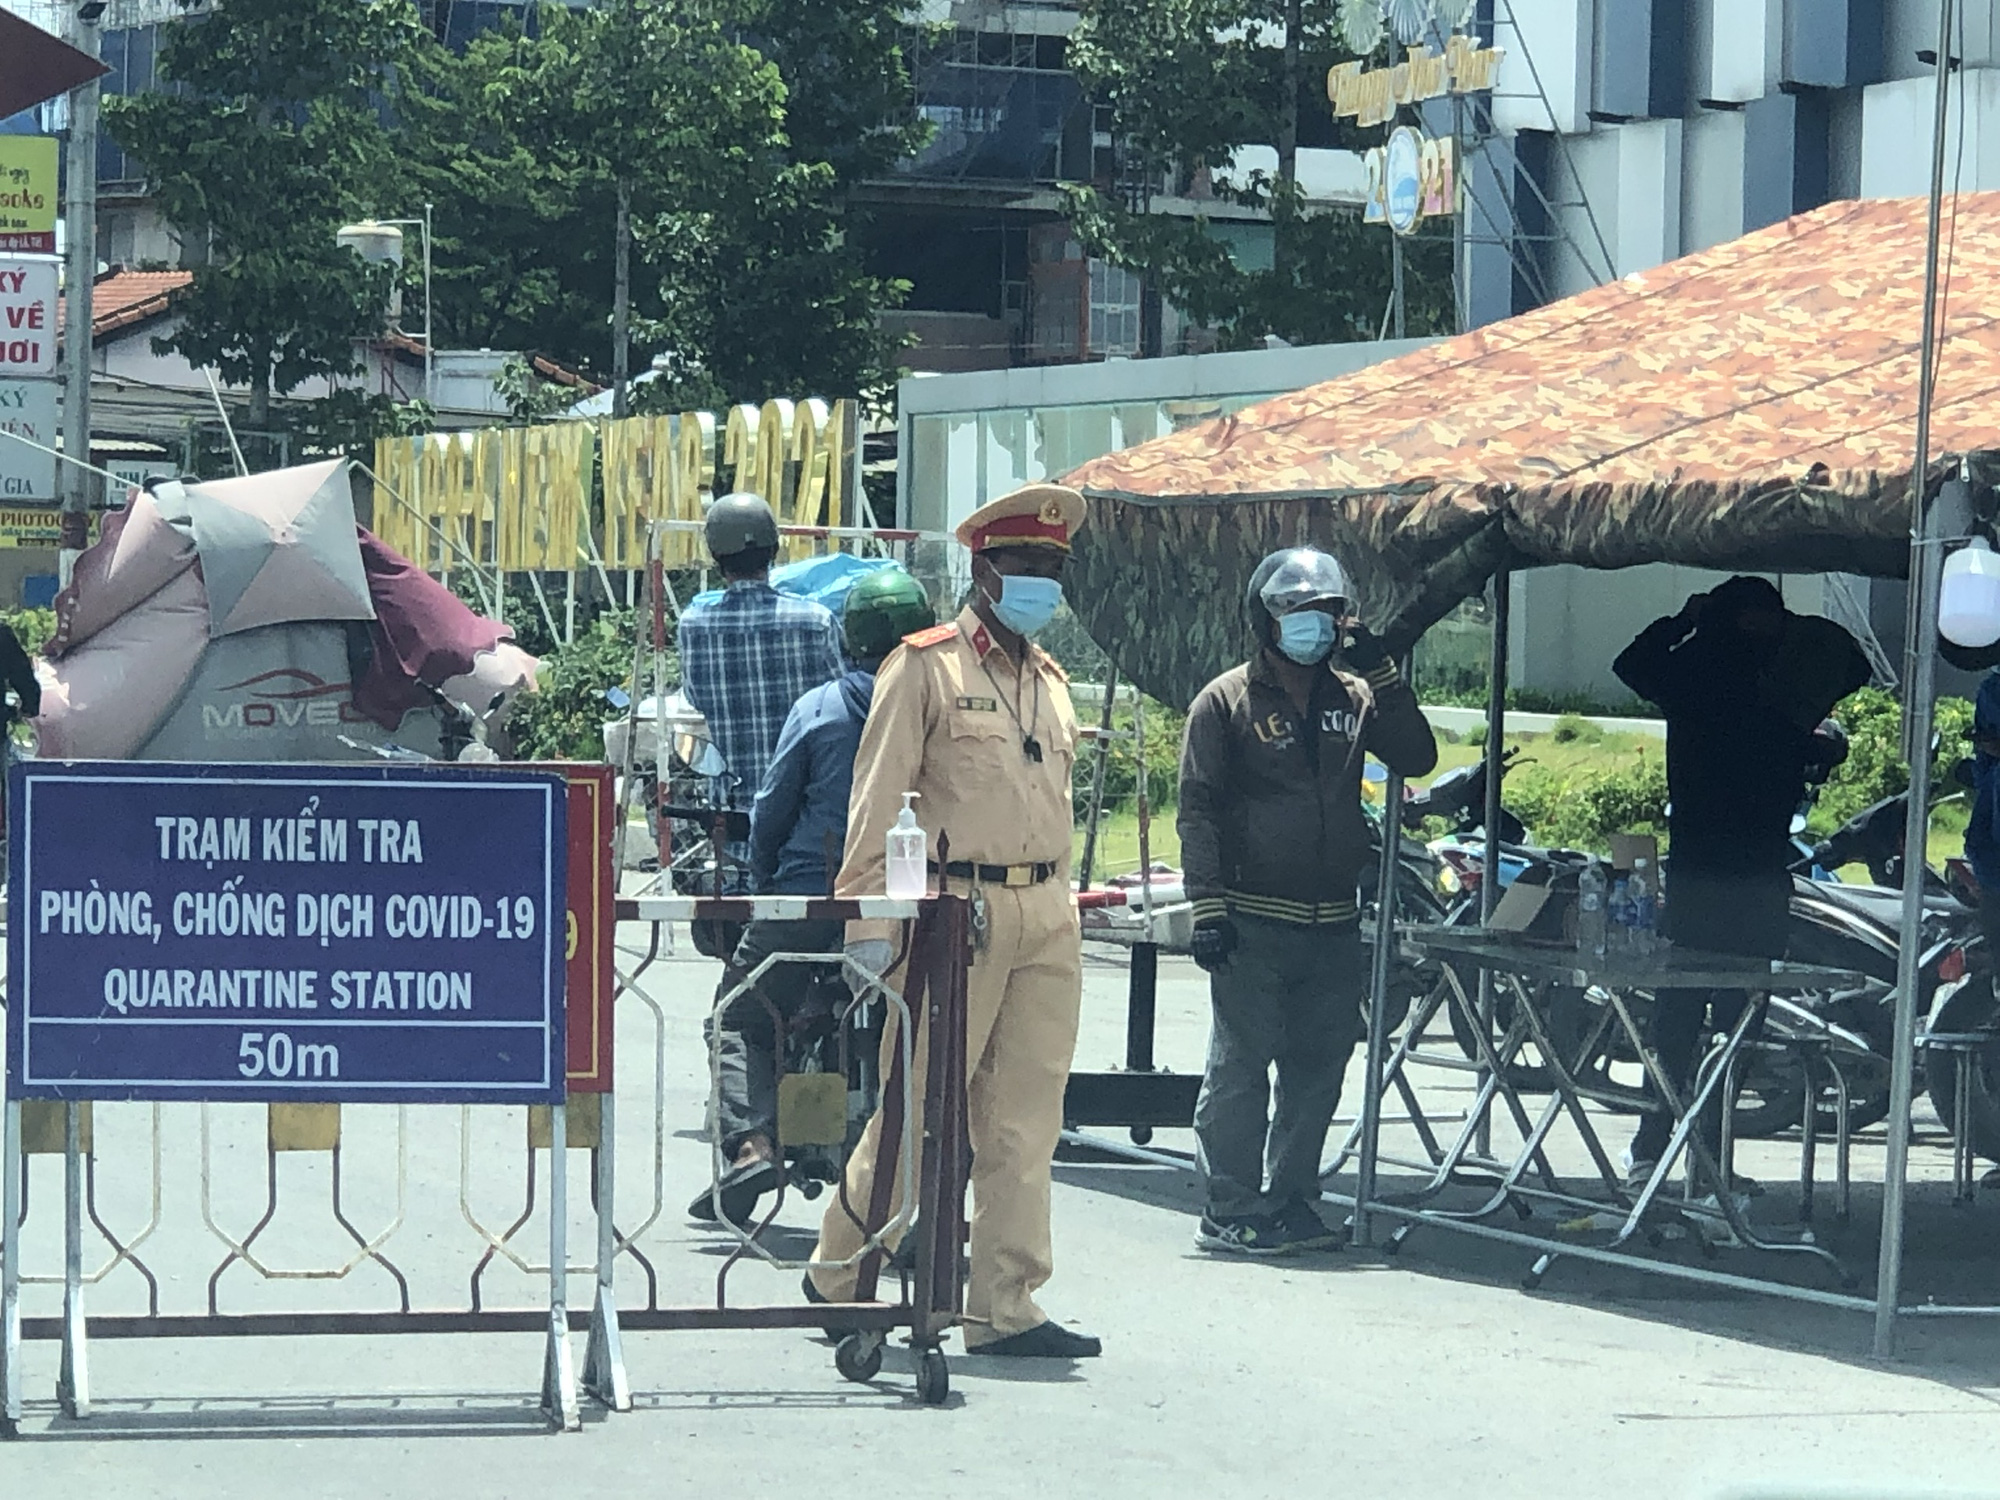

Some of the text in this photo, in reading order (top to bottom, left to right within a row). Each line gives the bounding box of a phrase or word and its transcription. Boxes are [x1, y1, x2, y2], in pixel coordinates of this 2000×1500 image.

[6, 299, 44, 330] VỀ
[600, 412, 714, 570] YEAR
[724, 398, 857, 563] 2021
[155, 795, 423, 869] TRẠM KIỂM TRA
[40, 875, 535, 946] PHÒNG, CHỐNG DỊCH COVID-19
[104, 967, 472, 1014] QUARANTINE STATION
[238, 1032, 339, 1077] 50m
